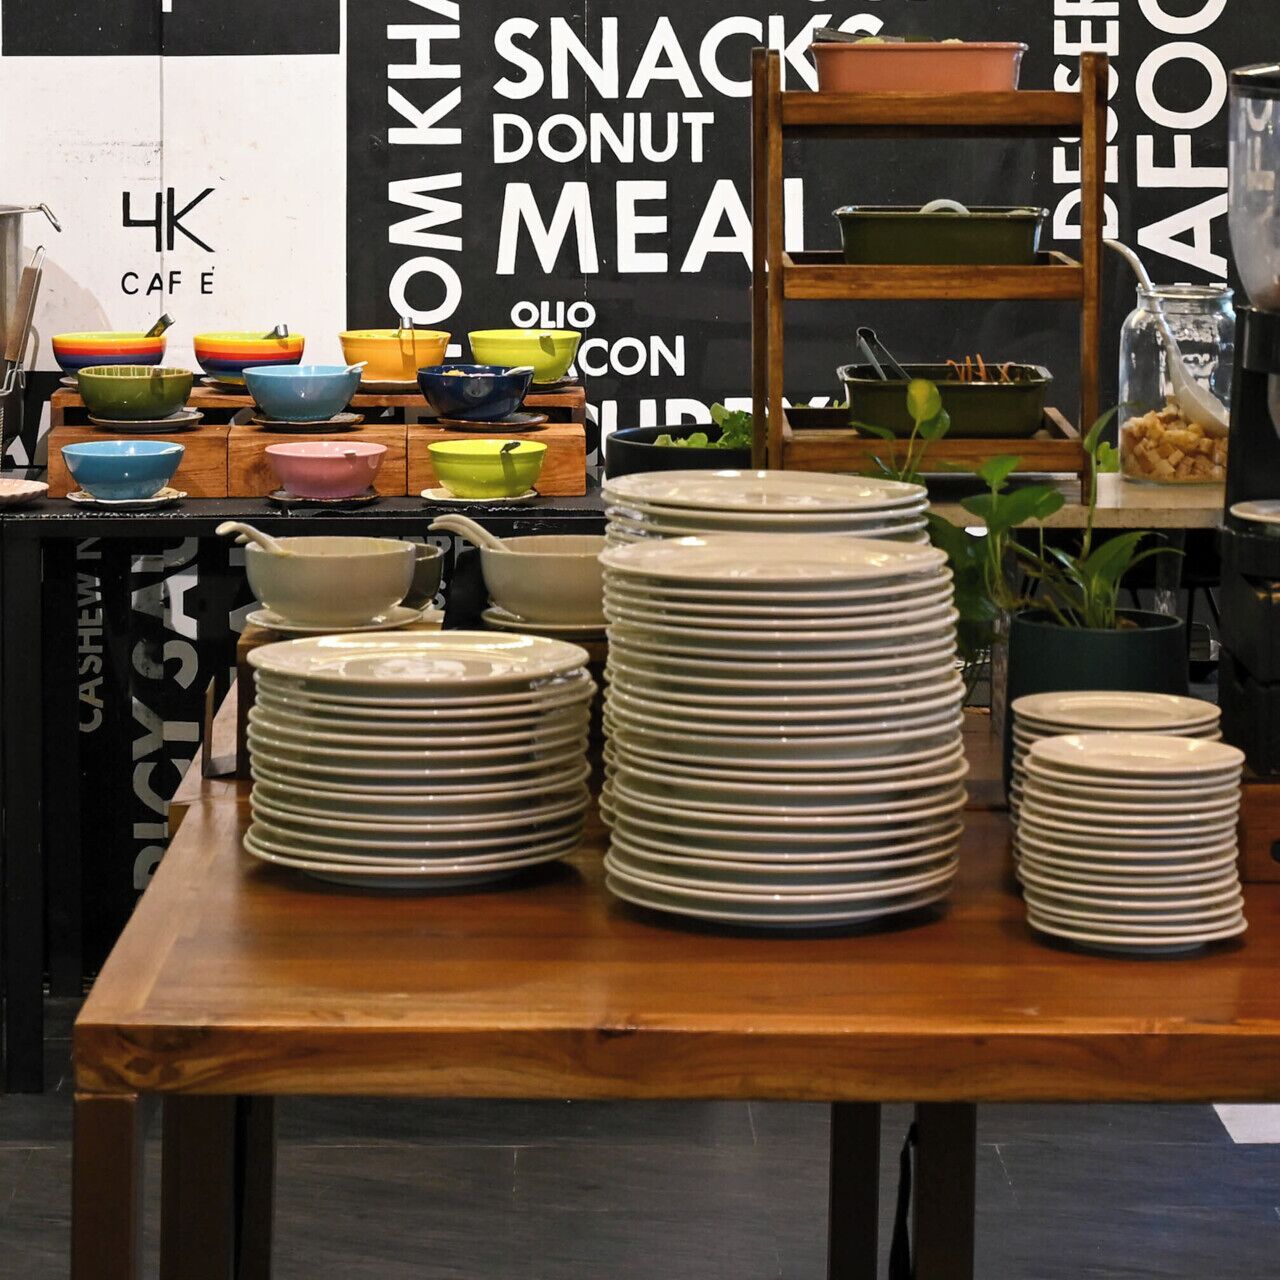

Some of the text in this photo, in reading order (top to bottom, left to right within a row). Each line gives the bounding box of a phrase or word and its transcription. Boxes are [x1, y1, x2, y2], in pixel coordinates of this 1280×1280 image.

[492, 14, 886, 100] SNACK
[492, 111, 715, 164] DONUT
[121, 187, 216, 253] 4K
[388, 173, 463, 358] OM
[510, 300, 596, 329] OLIO
[566, 335, 685, 377] CON
